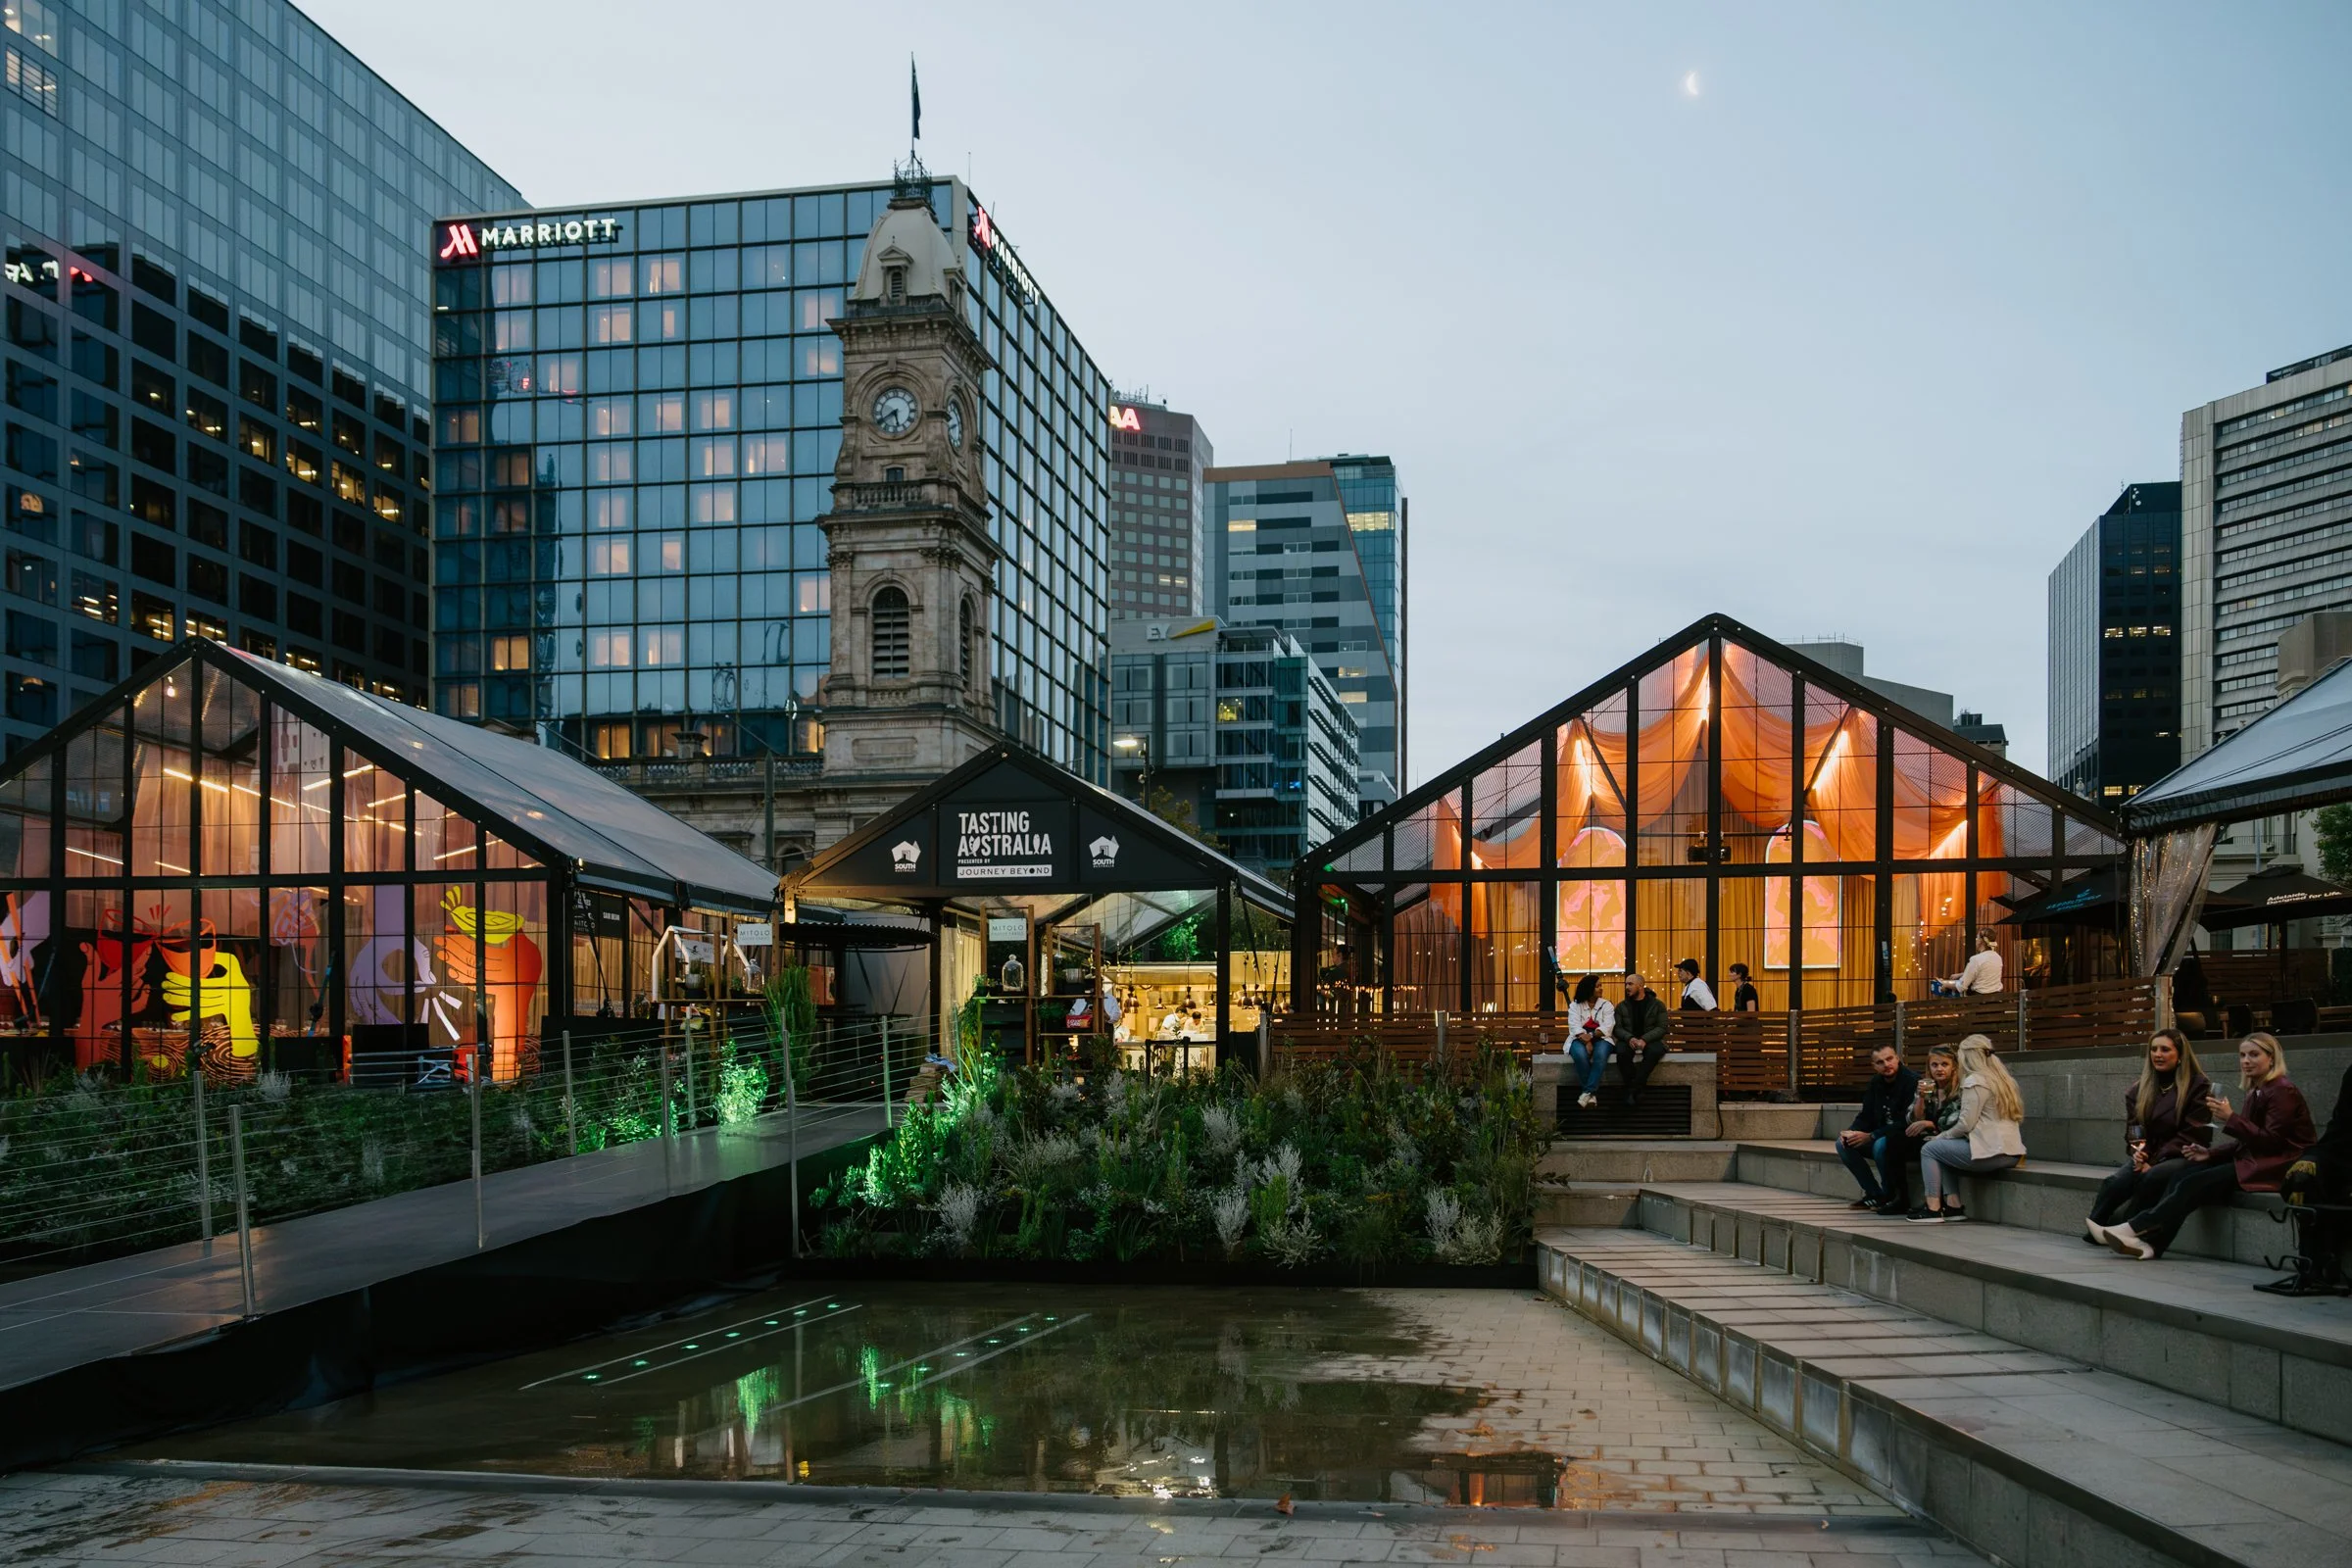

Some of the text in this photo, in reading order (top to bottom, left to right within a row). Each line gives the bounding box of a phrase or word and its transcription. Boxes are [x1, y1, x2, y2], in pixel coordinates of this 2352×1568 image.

[481, 218, 615, 247] MARRIOTT
[991, 228, 1039, 306] MARRIOTT
[1147, 623, 1171, 641] EY
[958, 810, 1030, 834] TASTING
[957, 833, 1053, 858] AUSTRALIA
[959, 866, 1050, 876] JOURNEY BEYOND
